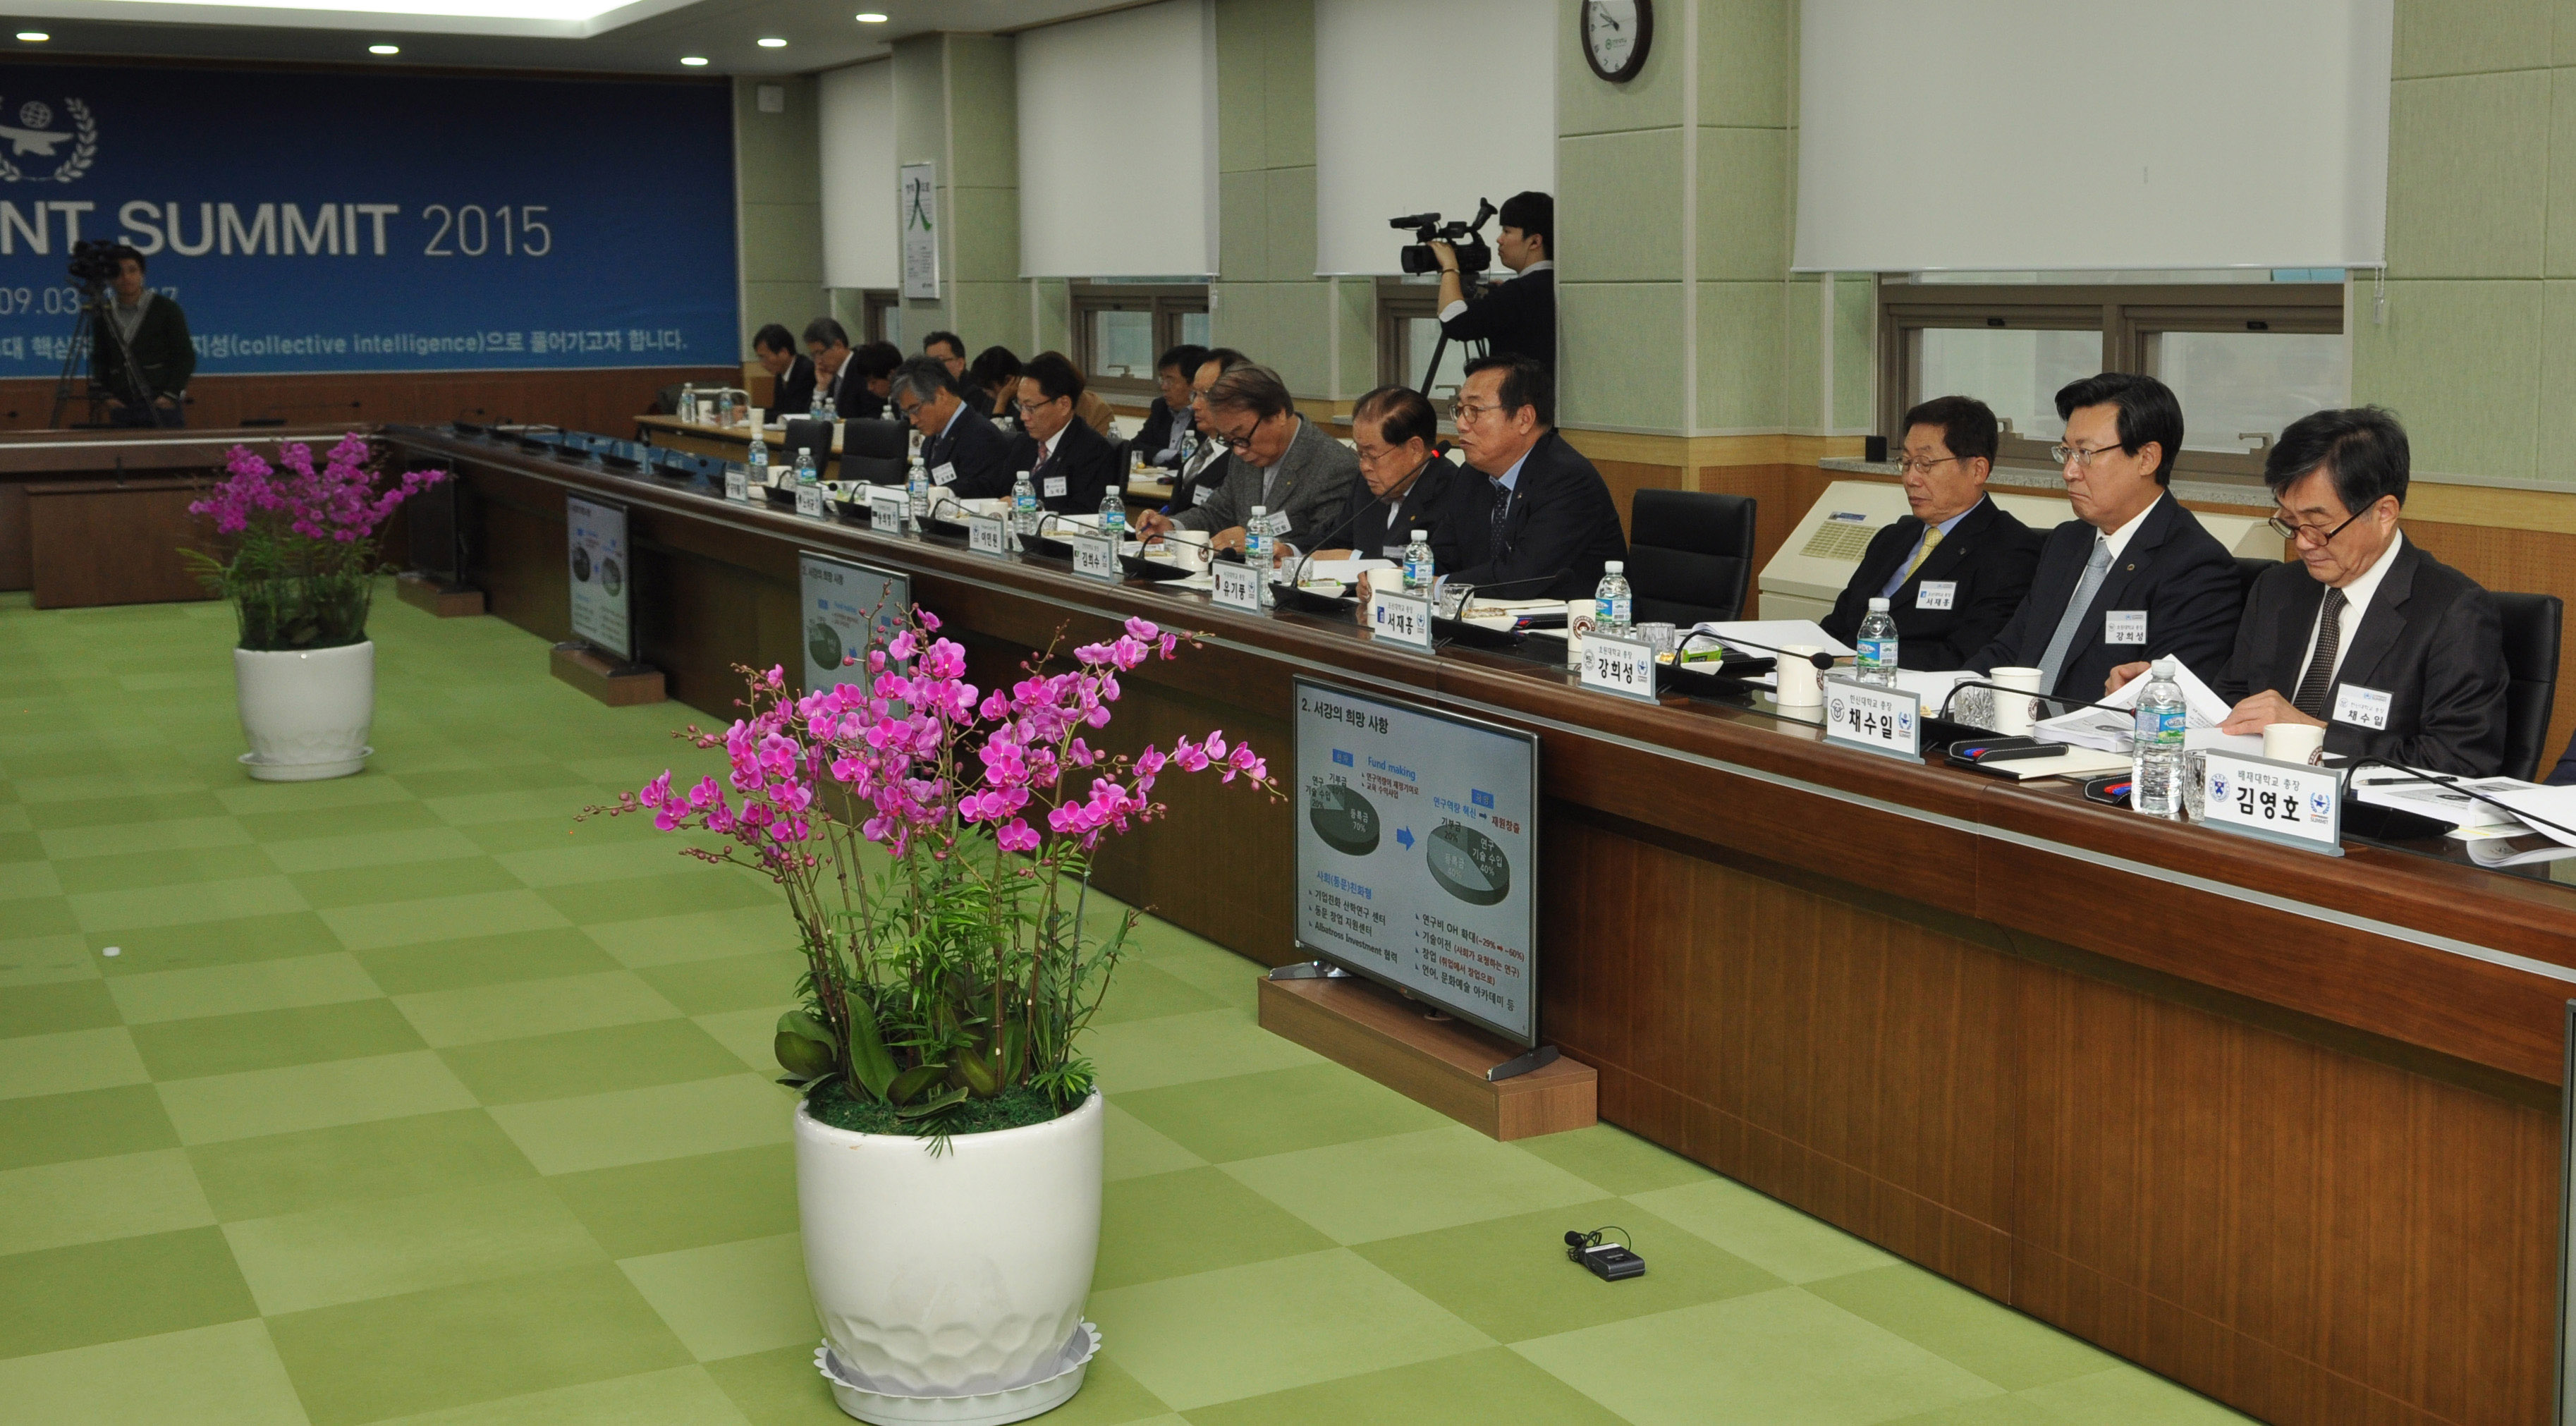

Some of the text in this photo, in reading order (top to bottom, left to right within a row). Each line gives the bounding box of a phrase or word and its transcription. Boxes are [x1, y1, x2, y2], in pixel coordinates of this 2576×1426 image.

[118, 200, 400, 256] SUMMIT
[423, 204, 552, 257] 2015
[628, 328, 688, 352] 합니다.
[1223, 580, 1246, 601] 유기풍
[1926, 598, 1951, 607] 서재홍
[1387, 613, 1414, 635] 서재홍
[2116, 632, 2144, 642] 강희성
[1598, 658, 1633, 684] 강희성
[1850, 694, 1892, 712] 한신대학교 총장
[1302, 697, 1389, 735] 2. 서강의 희망 사항
[1848, 707, 1893, 740] 채수일
[2348, 709, 2384, 727] 채수일
[1368, 756, 1417, 782] Fund making
[1312, 774, 1324, 788] 연구
[1329, 772, 1347, 789] 기부금
[2238, 769, 2300, 792] 배재대학교 총장
[1319, 789, 1331, 803] 수입
[2235, 786, 2301, 822] 김영호
[1433, 796, 1460, 814] 연구역량
[1491, 815, 1521, 835] 재원창출
[1441, 817, 1462, 833] 기부금
[1353, 821, 1367, 834] 70%
[1480, 837, 1495, 852] 연구
[1472, 848, 1503, 868] 기술 수입
[1480, 863, 1496, 877] 40%
[1314, 889, 1386, 927] 기업친화 산학연구 센터
[1314, 905, 1373, 938] 동문 창업 지원센터
[1422, 913, 1444, 932] 연구비
[1446, 922, 1458, 937] OH
[1314, 920, 1345, 941] Albatross
[1345, 932, 1383, 957] Investment
[1422, 930, 1452, 952] 기술이전
[1504, 963, 1520, 979] 연구)
[1422, 947, 1437, 964] 창업
[1441, 971, 1471, 994] 문화예술
[1473, 985, 1504, 1008] 아카데미
[1506, 998, 1515, 1013] 등
